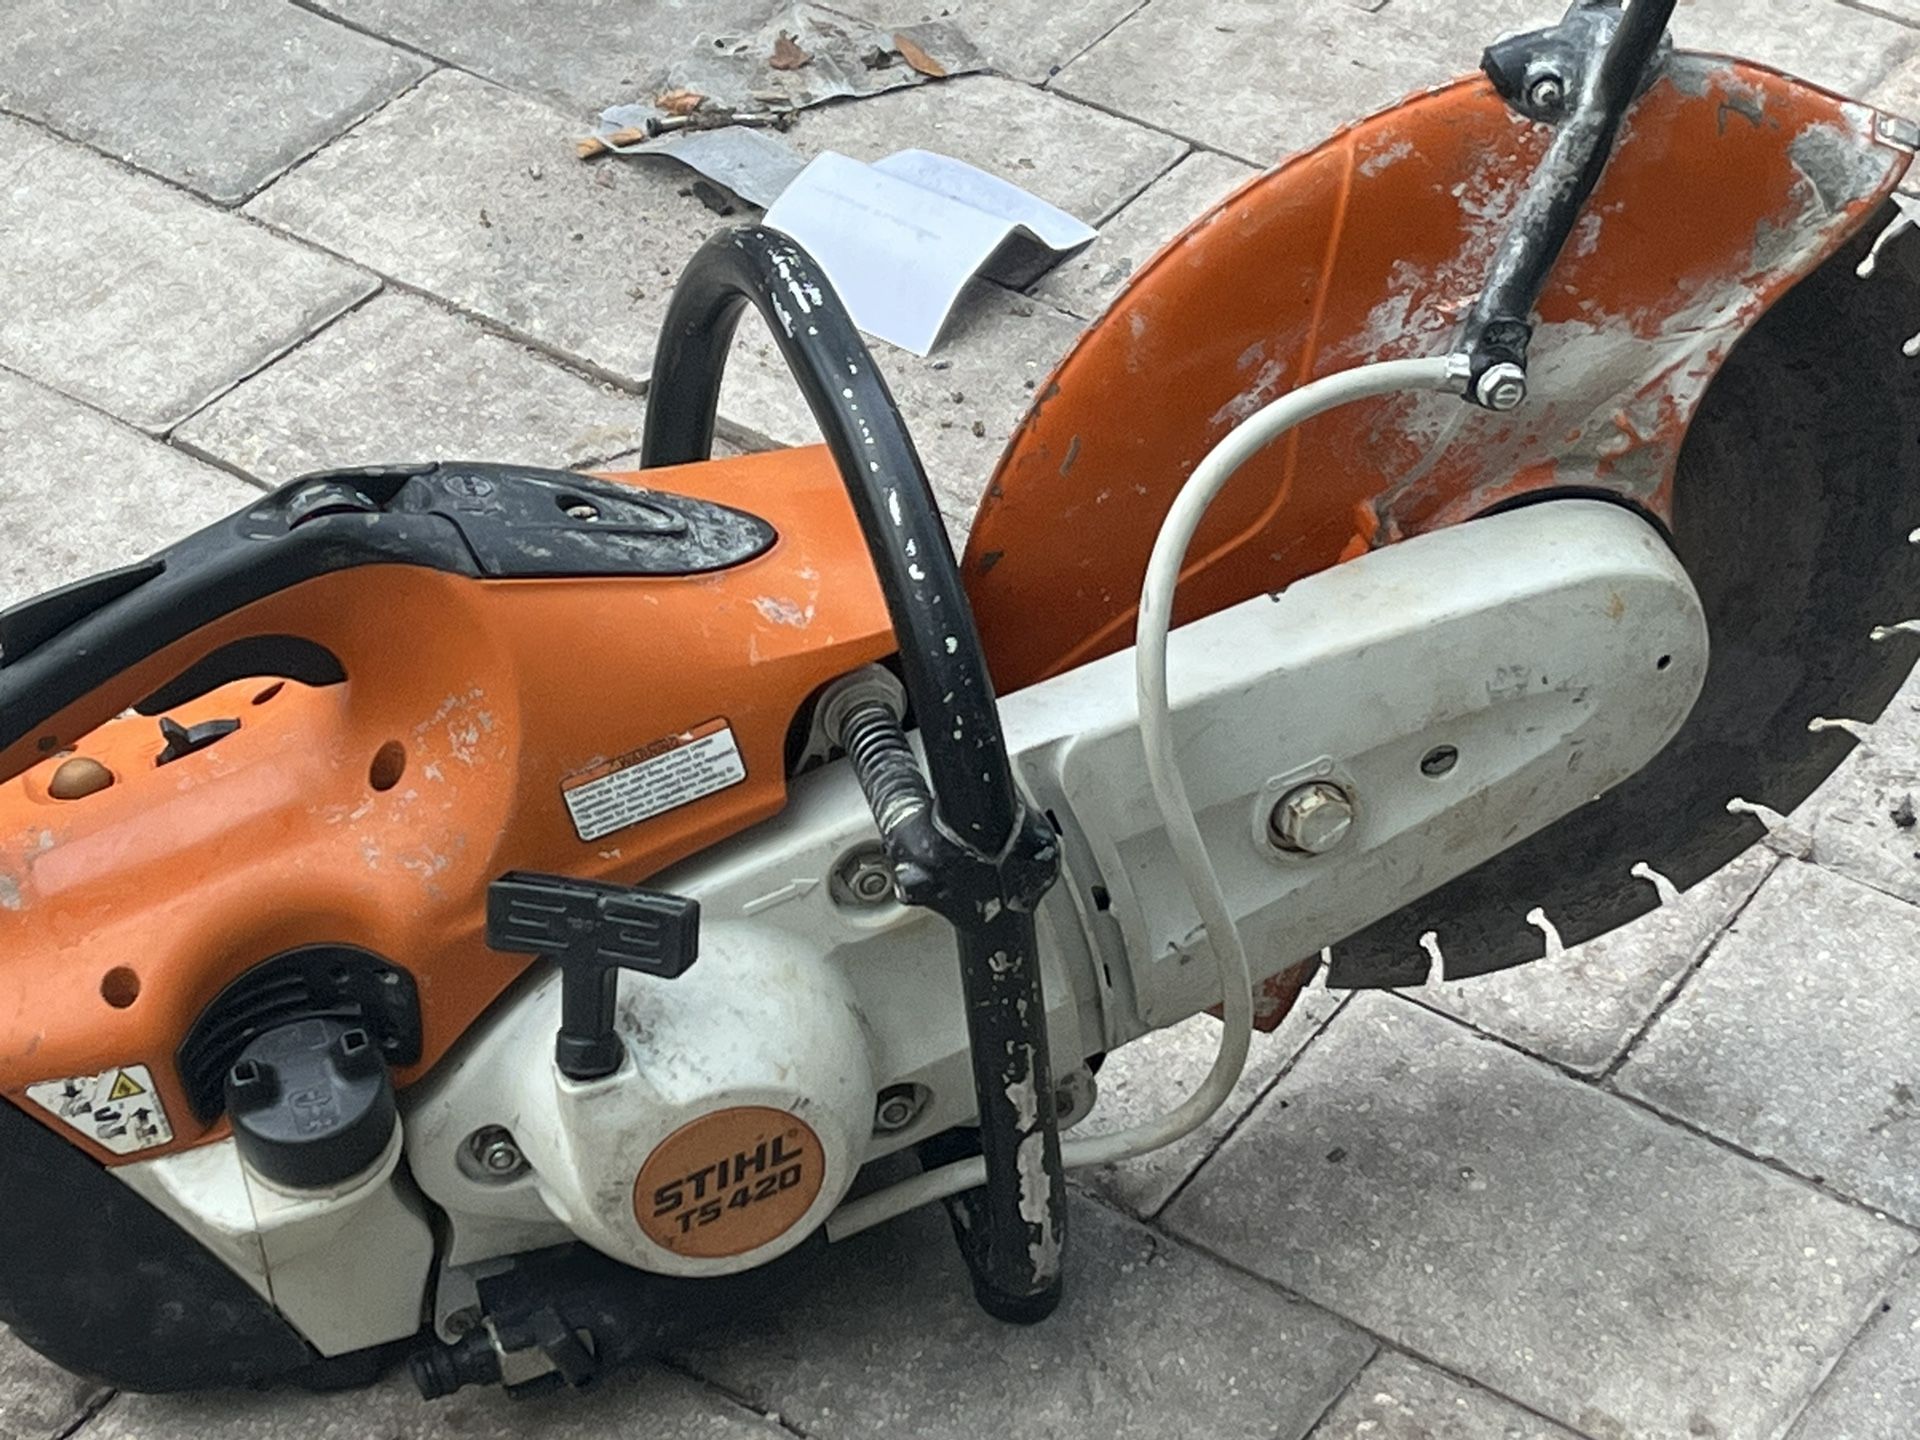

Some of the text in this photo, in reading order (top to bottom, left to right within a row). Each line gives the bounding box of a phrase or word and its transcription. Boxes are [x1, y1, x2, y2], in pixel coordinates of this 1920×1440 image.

[653, 1134, 803, 1217] STIHL
[674, 1163, 802, 1233] TS 420
